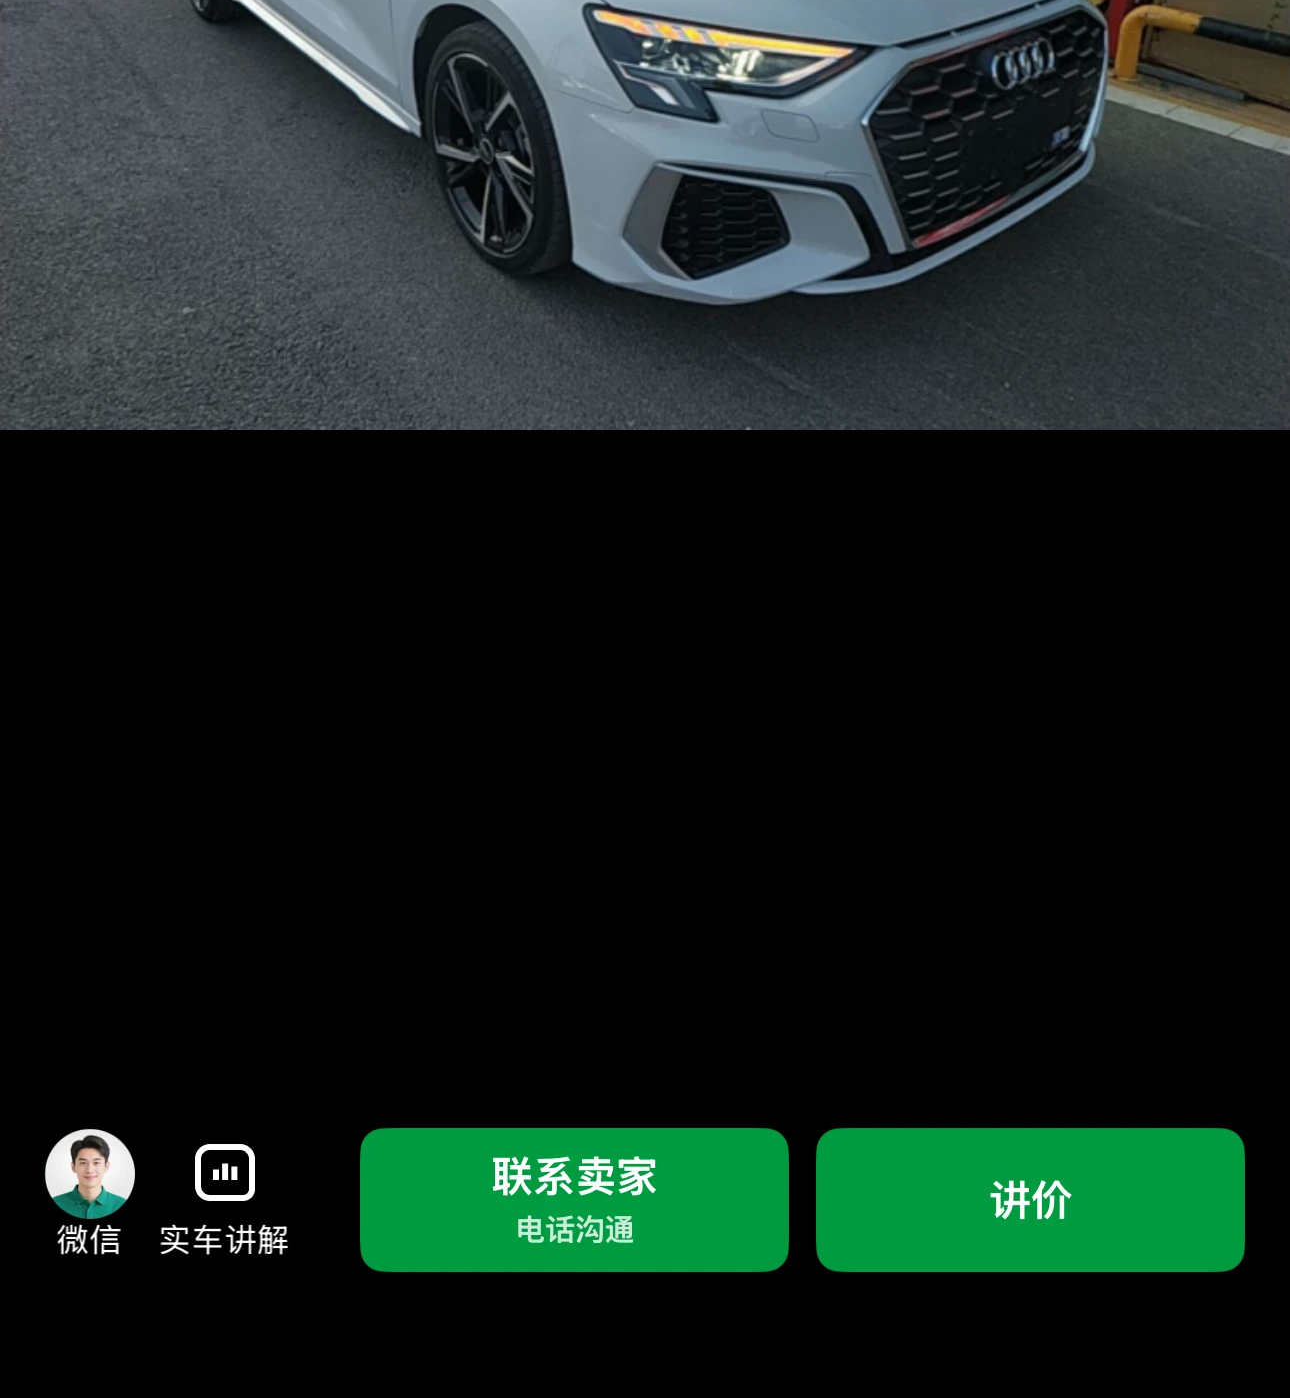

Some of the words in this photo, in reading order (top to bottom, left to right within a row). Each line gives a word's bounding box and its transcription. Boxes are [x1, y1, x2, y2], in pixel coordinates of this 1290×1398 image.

[493, 1156, 656, 1196] 联系卖家
[990, 1180, 1071, 1219] 讲价
[57, 1225, 121, 1255] 微信
[160, 1225, 288, 1255] 实车讲解
[518, 1215, 633, 1243] 电话沟通
